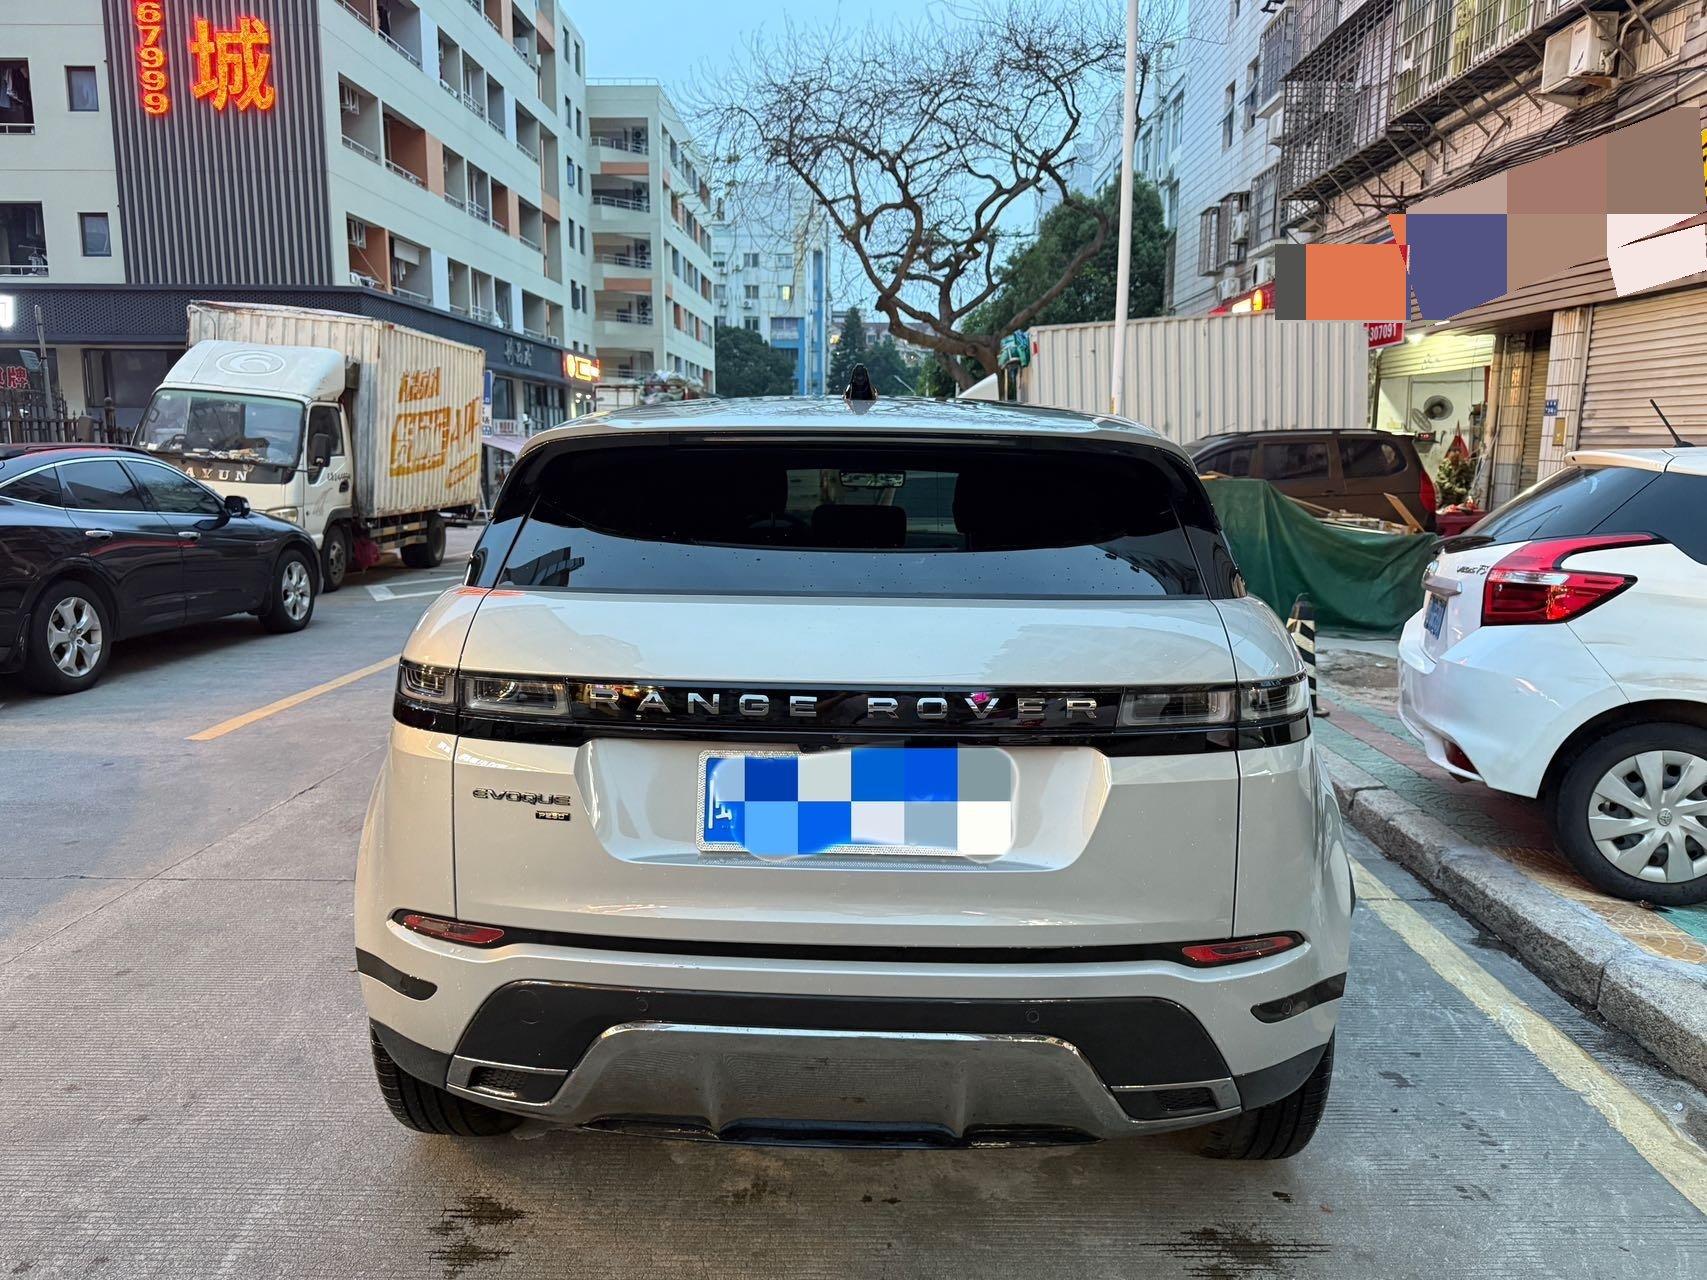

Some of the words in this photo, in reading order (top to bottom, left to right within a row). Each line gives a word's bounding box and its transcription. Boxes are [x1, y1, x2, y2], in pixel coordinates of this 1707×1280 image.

[190, 16, 275, 111] 城
[174, 464, 249, 481] AYUN
[584, 683, 818, 718] RANGE
[867, 697, 1098, 720] ROVER
[472, 787, 571, 806] EVOQUE
